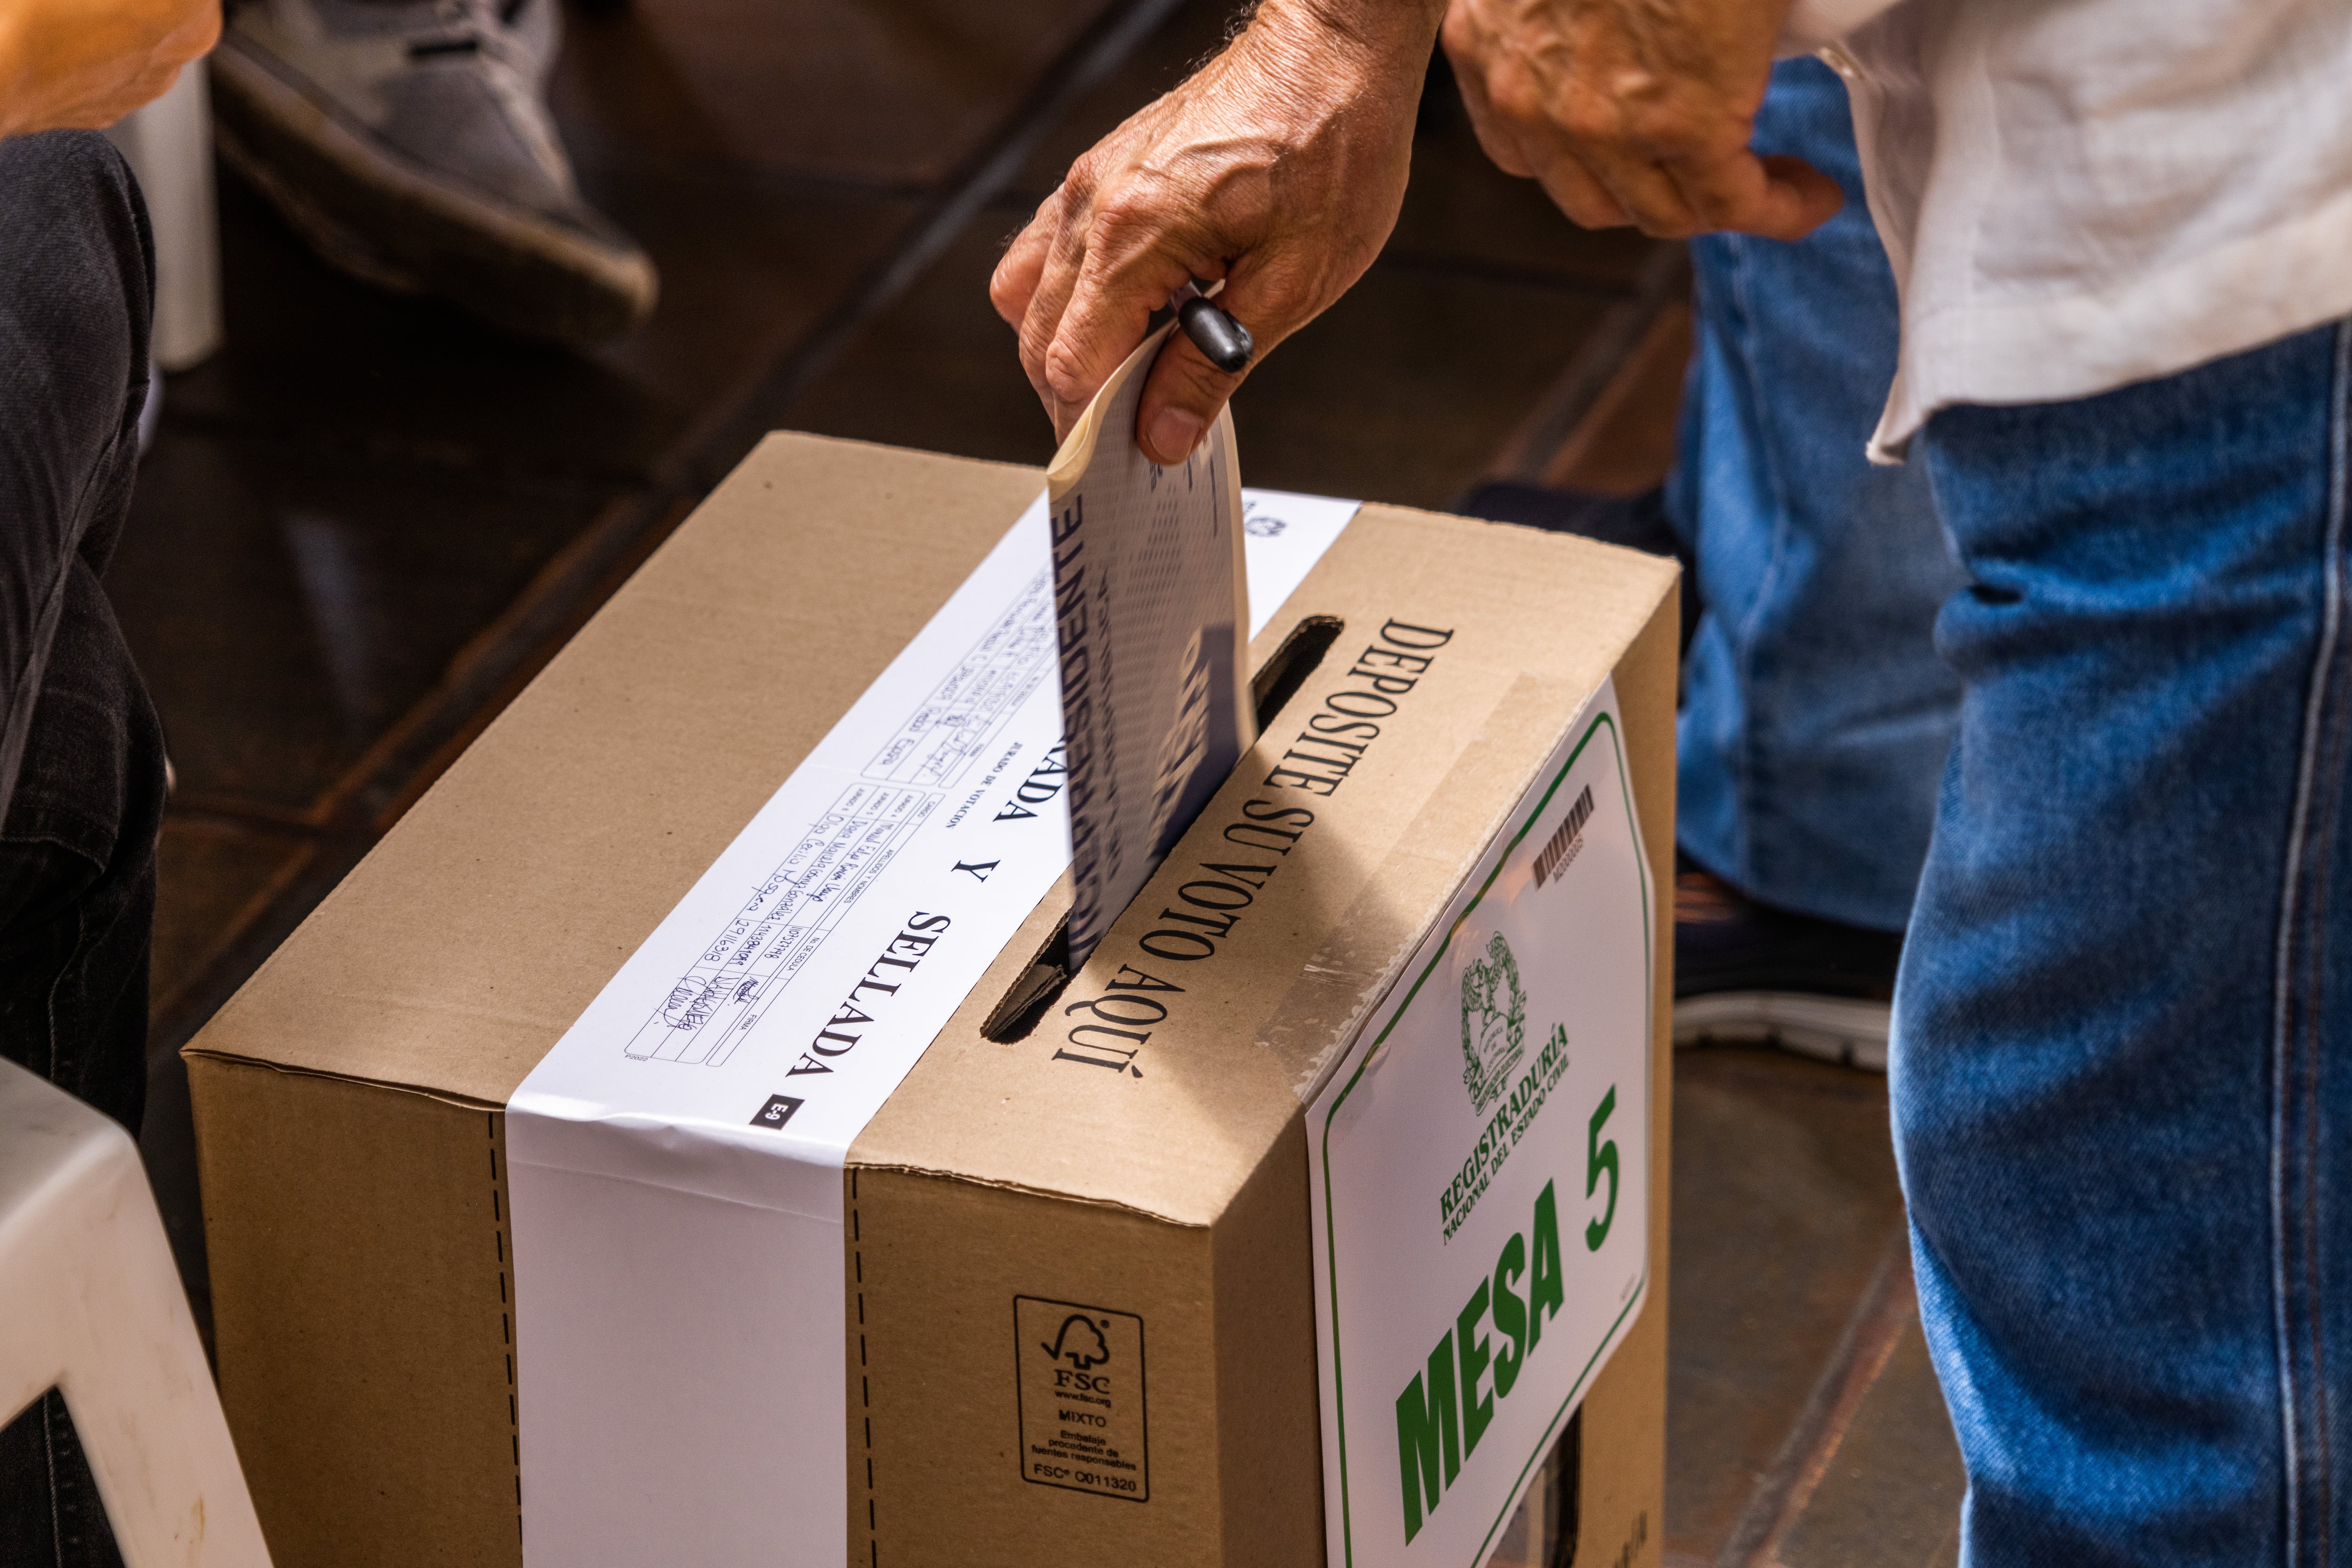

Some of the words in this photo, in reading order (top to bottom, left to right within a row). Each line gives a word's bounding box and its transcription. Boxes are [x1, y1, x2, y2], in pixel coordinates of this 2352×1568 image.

[1263, 617, 1454, 797] DEPOSITE
[993, 741, 1023, 773] JURADO
[981, 775, 996, 787] DE
[946, 789, 985, 829] VOTACION
[808, 814, 844, 834] Olga
[1223, 799, 1315, 857] SU
[787, 839, 825, 864] Cecilia
[869, 849, 894, 874] APELLIDOS
[951, 860, 1001, 883] Y
[746, 869, 799, 911] Mosquera
[844, 881, 868, 903] NOMBRES
[1138, 863, 1278, 961] VOTO
[704, 920, 749, 961] 29116318
[787, 953, 807, 971] CEDULA
[785, 911, 951, 1077] SELLADA
[739, 1014, 757, 1030] FIRMA
[1051, 963, 1185, 1079] AQUÍ
[764, 1103, 789, 1121] E-9
[1440, 1022, 1569, 1224] REGISTRADURÍA
[1443, 1172, 1490, 1246] NACIONAL
[1491, 1142, 1510, 1177] DEL
[1511, 1087, 1546, 1146] ESTADO
[1548, 1053, 1569, 1092] CIVIL
[1395, 1176, 1564, 1548] MESA
[1585, 1082, 1619, 1252] 5
[1054, 1369, 1111, 1395] FSC
[1055, 1390, 1112, 1408] www.fsc.org
[1059, 1409, 1106, 1428] MIXTO
[1049, 1438, 1104, 1456] procedente
[1106, 1449, 1119, 1458] de
[1060, 1430, 1106, 1446] Embalaje
[1031, 1444, 1068, 1459] fuentes
[1071, 1452, 1136, 1471] responsables
[1075, 1470, 1136, 1492] C011320
